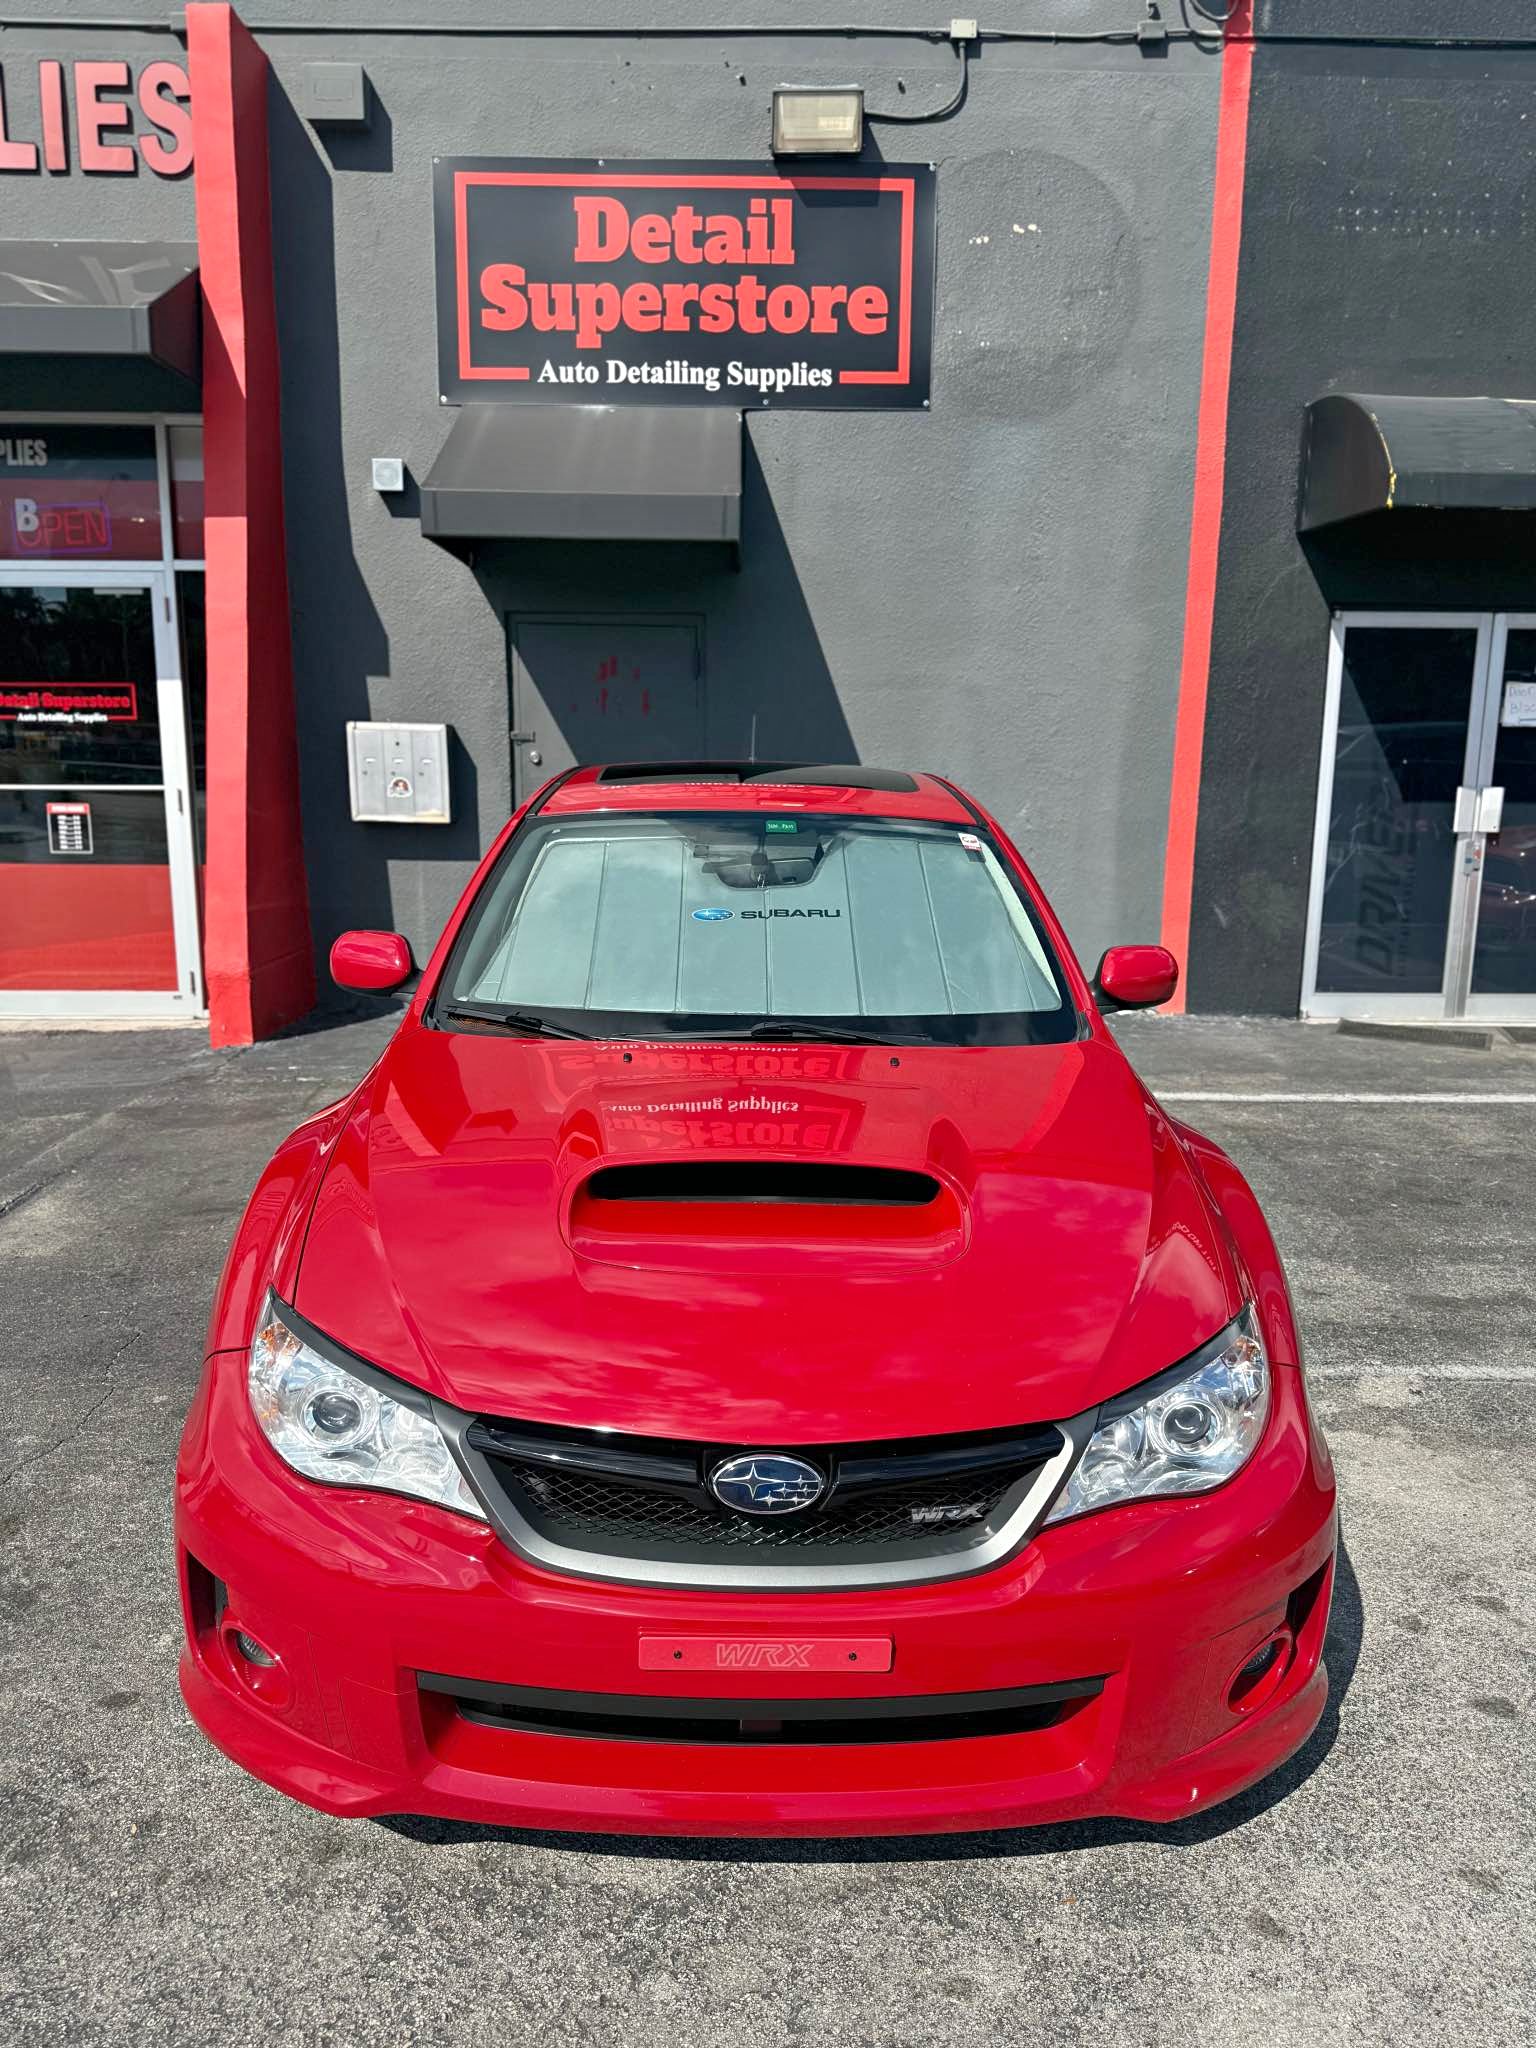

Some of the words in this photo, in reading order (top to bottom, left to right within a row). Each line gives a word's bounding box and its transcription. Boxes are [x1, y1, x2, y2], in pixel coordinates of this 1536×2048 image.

[573, 196, 795, 265] Detail
[480, 264, 888, 348] Superstore
[537, 360, 600, 385] Auto
[606, 360, 720, 391] Detailing
[727, 362, 833, 392] Supplies
[42, 692, 130, 711] Superstore
[17, 712, 37, 722] Auto
[741, 909, 841, 919] SUBARU
[911, 1502, 987, 1524] WRX
[715, 1643, 815, 1667] WRX
